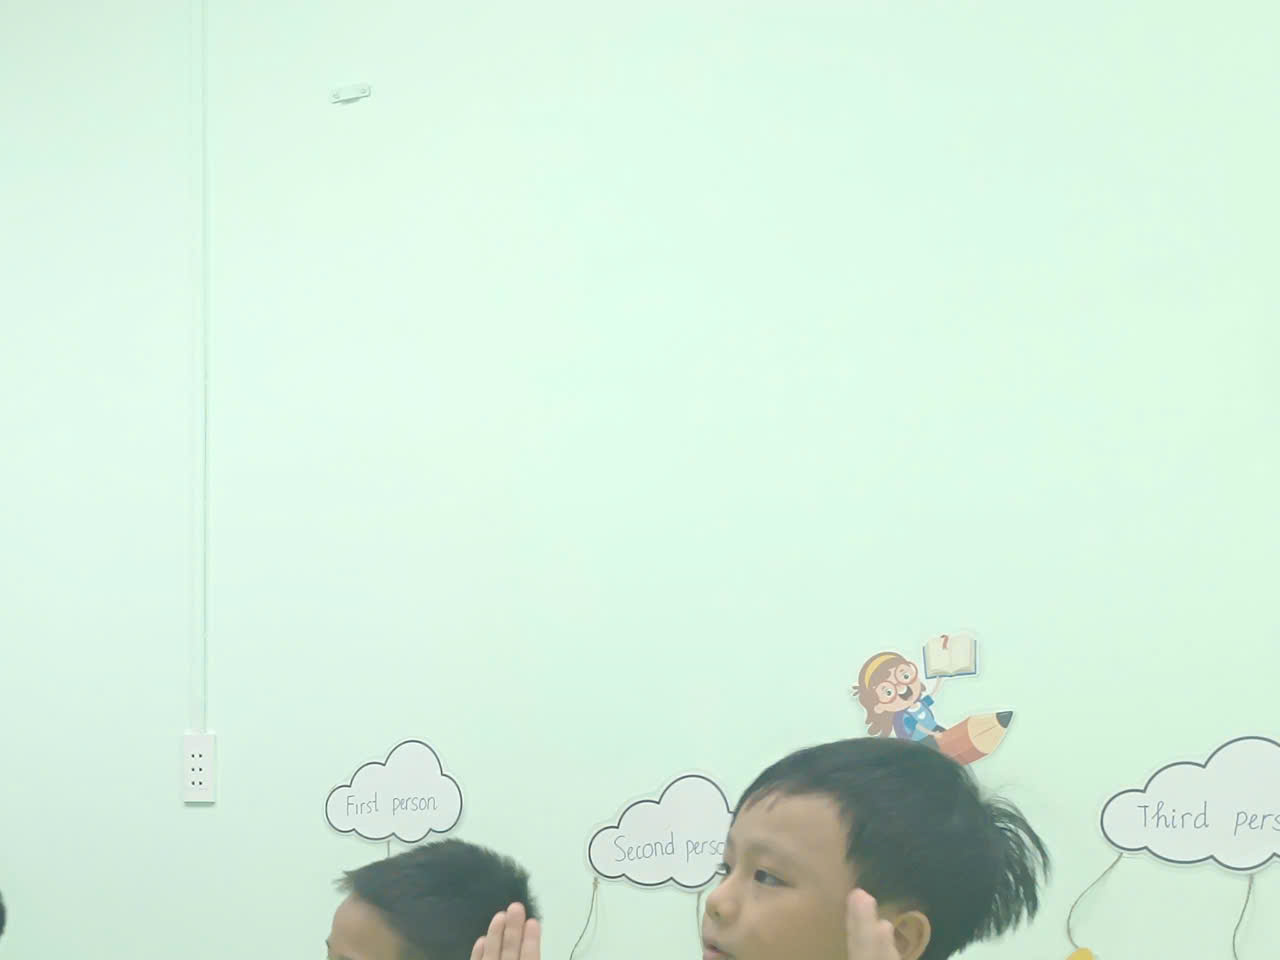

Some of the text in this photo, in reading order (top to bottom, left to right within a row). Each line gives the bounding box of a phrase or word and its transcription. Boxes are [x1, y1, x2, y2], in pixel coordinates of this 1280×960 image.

[346, 792, 439, 815] First person
[1137, 801, 1209, 830] Third
[614, 832, 675, 863] Second
